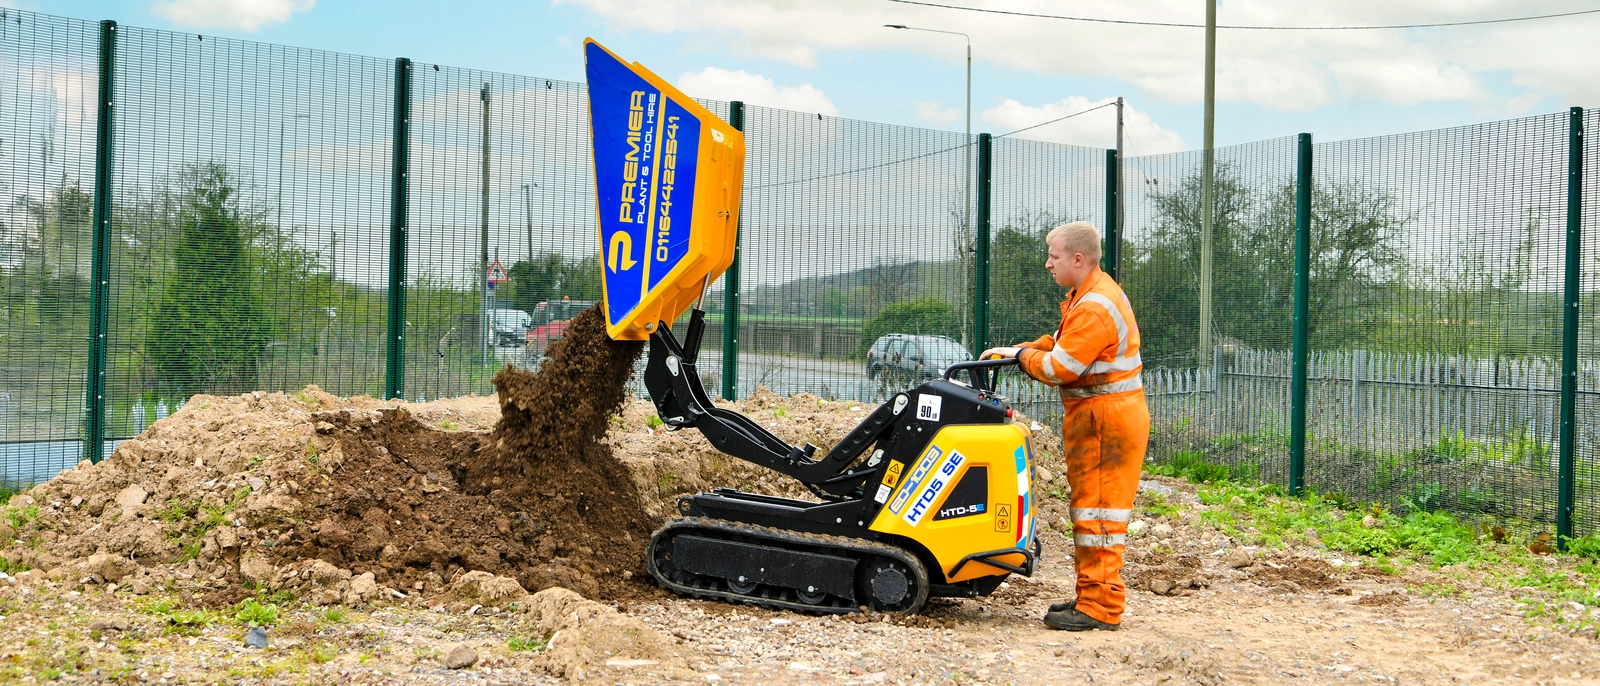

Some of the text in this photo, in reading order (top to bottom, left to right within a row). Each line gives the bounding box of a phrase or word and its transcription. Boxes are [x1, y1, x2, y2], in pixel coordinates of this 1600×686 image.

[619, 90, 645, 223] PREMIER
[637, 93, 657, 224] PLANT & TOOL HIRE
[656, 116, 680, 262] 01164422541
[921, 405, 932, 418] 90
[890, 447, 940, 512] ED-1003
[907, 452, 963, 522] HTD5 SE
[940, 503, 985, 518] HTD-5E
